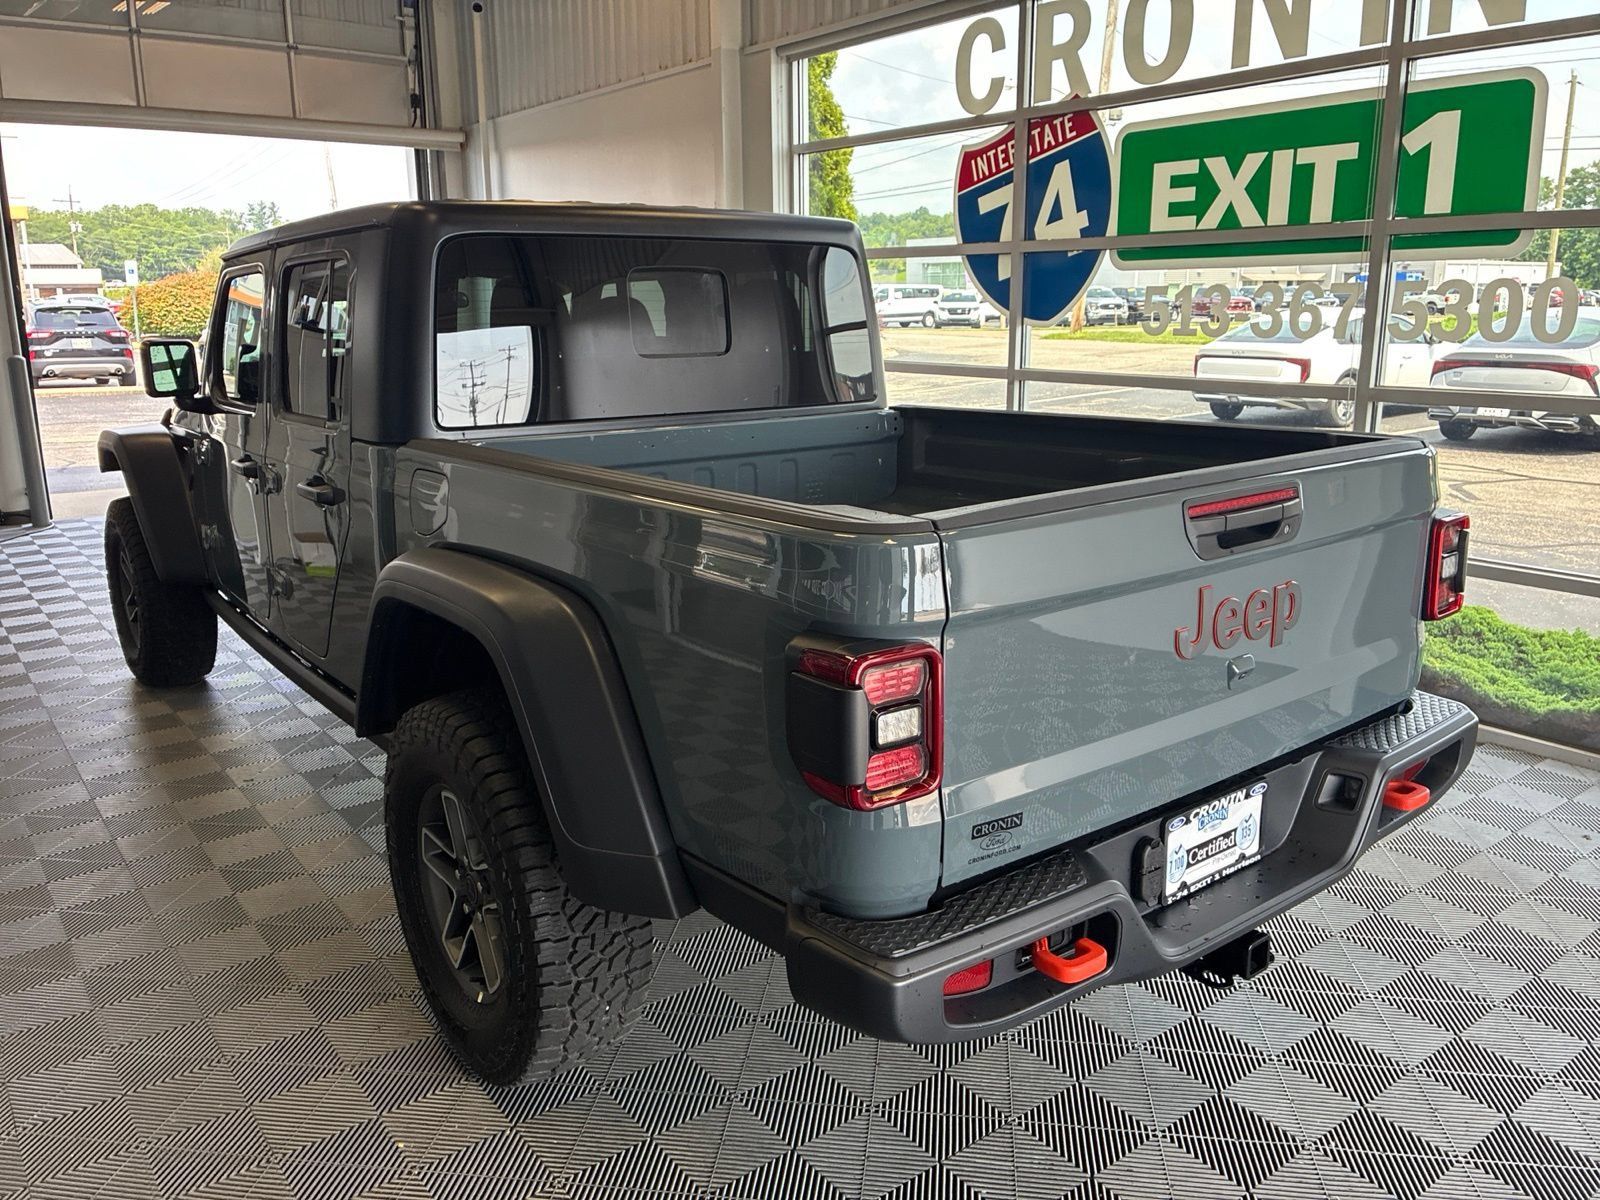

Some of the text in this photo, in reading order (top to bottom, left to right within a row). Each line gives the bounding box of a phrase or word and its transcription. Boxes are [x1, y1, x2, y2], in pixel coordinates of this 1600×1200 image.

[955, 0, 1526, 115] CRON
[971, 113, 1077, 182] INTERTATE
[1150, 109, 1472, 233] EXIT 1
[977, 159, 1090, 282] 74
[1141, 277, 1579, 344] 513-3675300
[1174, 580, 1302, 661] Jeep
[973, 814, 1022, 837] CRONIN
[1190, 788, 1247, 822] CRONIN
[1198, 808, 1229, 831] CRONIN
[967, 844, 1022, 865] CRONINFORD.COM
[1188, 831, 1235, 864] Certified
[1167, 888, 1189, 905] I-74
[1189, 876, 1213, 893] EXIT
[1222, 854, 1262, 877] Harrison
